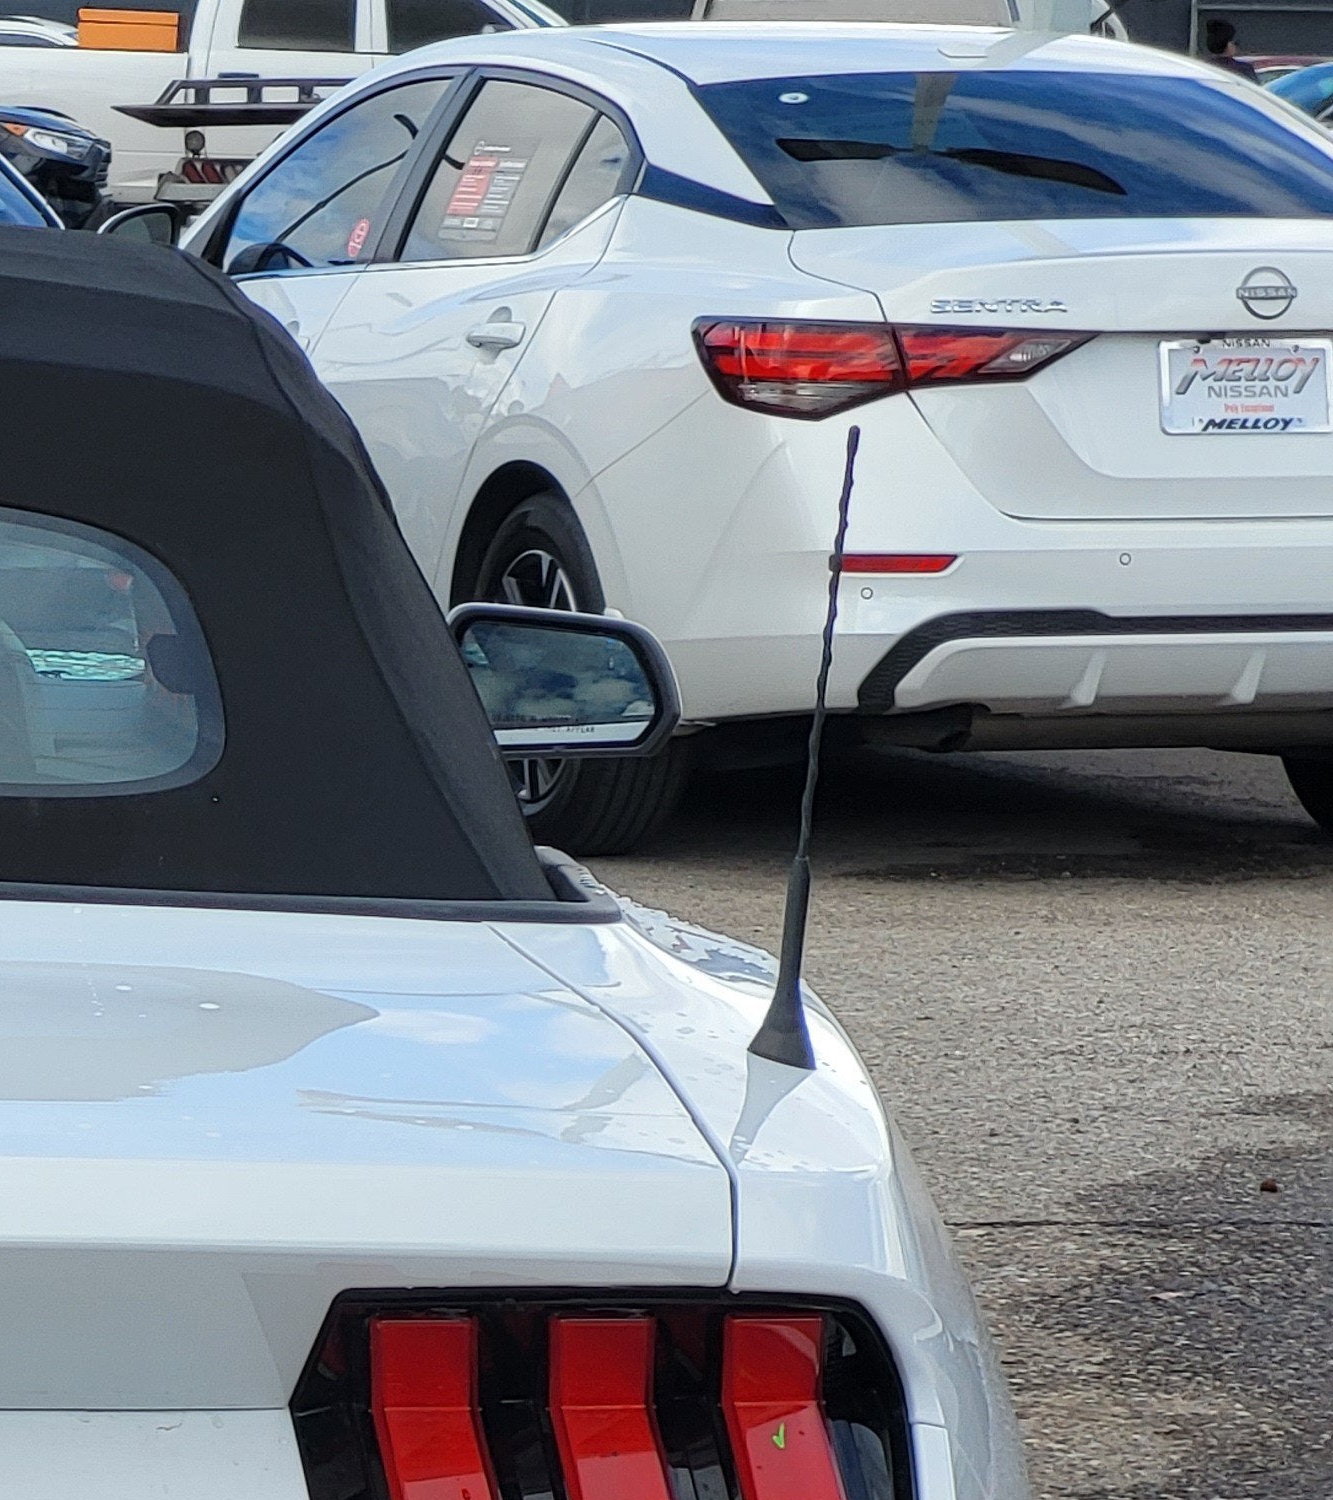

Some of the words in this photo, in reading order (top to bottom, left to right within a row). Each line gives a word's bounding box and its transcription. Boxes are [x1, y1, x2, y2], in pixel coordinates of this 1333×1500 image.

[1236, 284, 1297, 300] NISSAN
[930, 299, 1067, 313] SENTRA
[1222, 338, 1271, 348] NISSAN
[1175, 357, 1320, 396] MELLOY
[1207, 384, 1289, 399] NISSAN
[1202, 417, 1294, 431] MELLOY
